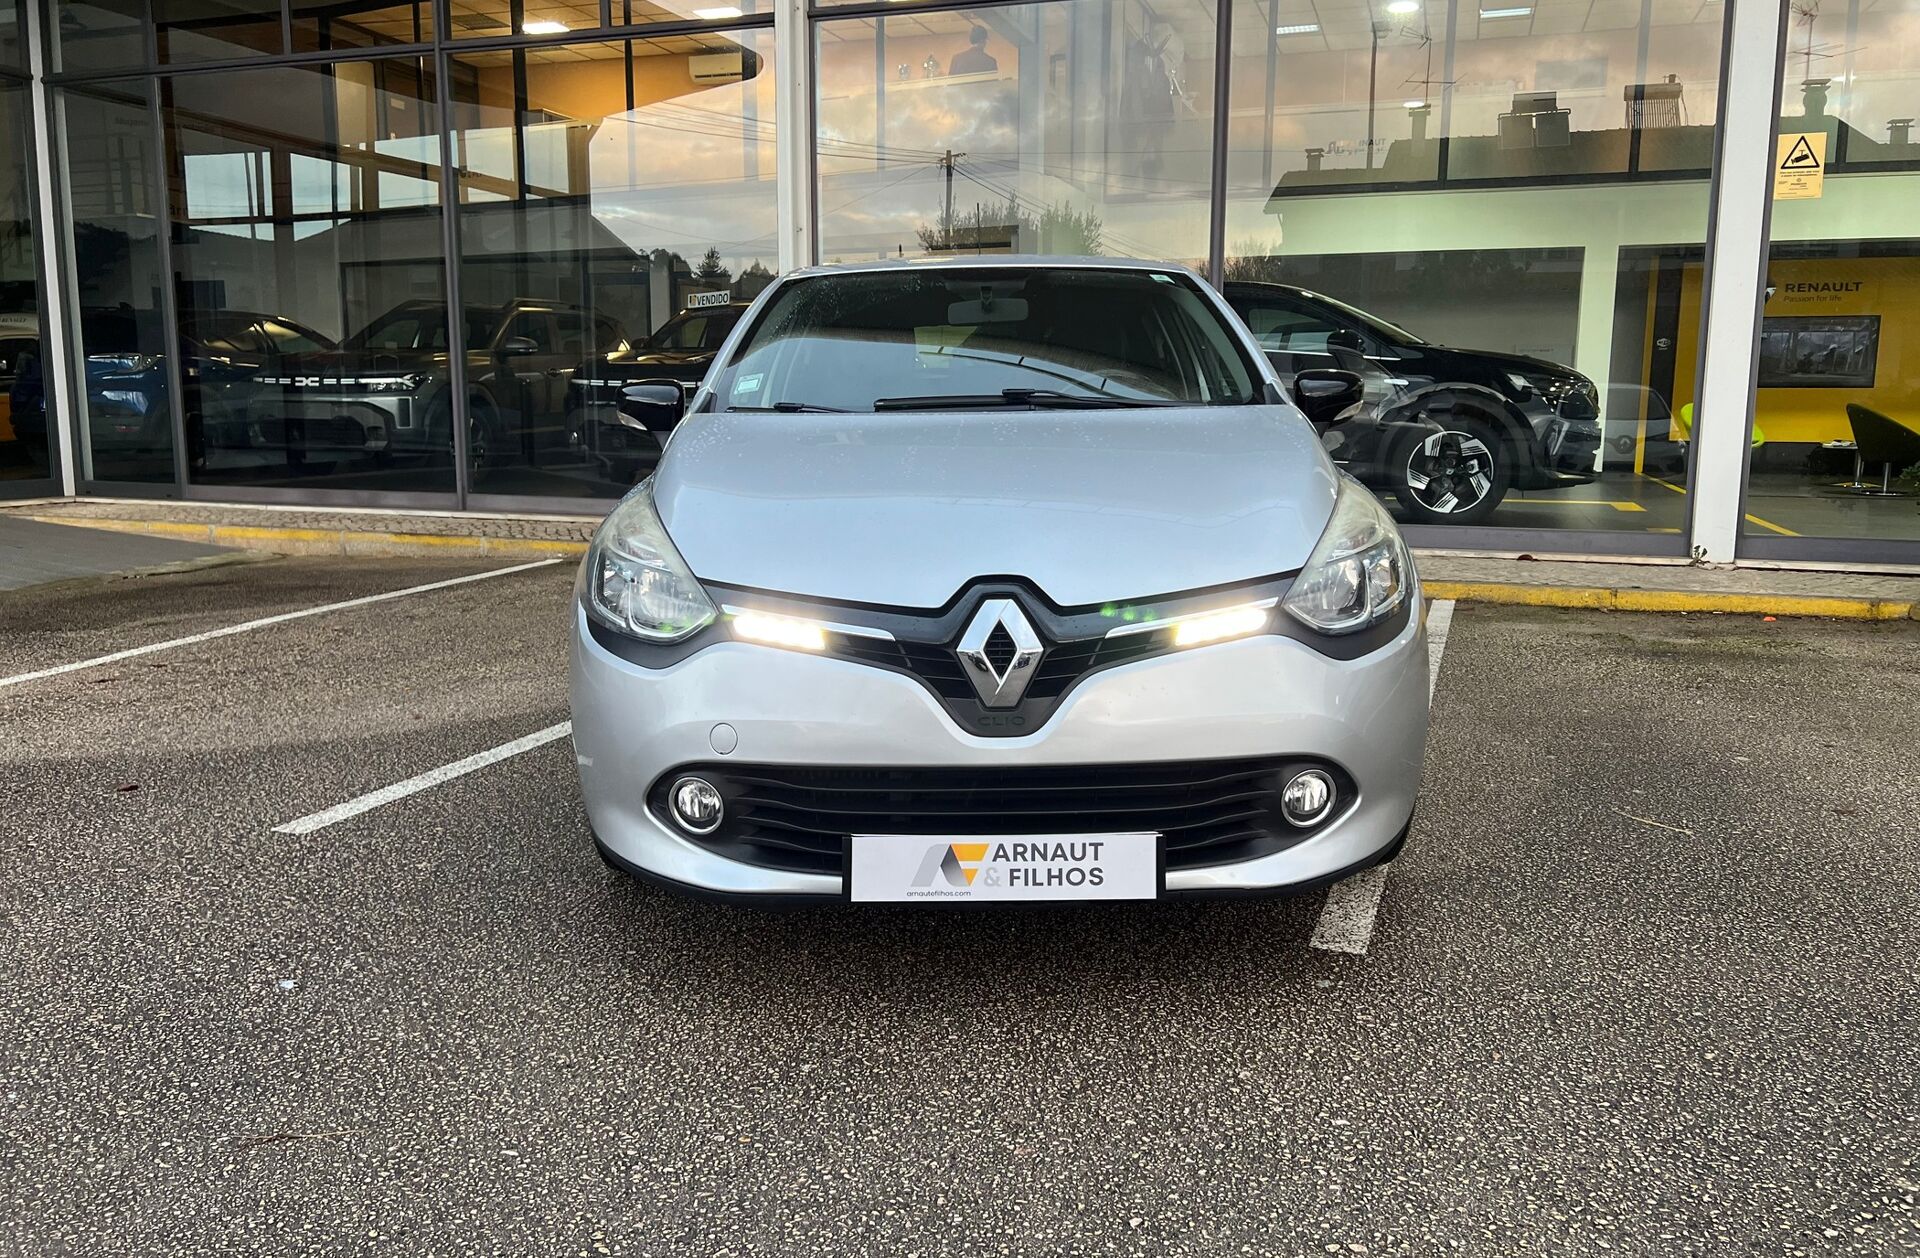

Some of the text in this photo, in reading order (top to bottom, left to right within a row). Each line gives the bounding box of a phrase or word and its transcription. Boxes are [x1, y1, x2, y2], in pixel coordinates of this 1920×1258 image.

[1785, 282, 1863, 292] RENAULT
[696, 293, 729, 306] VENDIDO
[1816, 294, 1827, 302] for
[1829, 294, 1842, 302] life
[977, 716, 1026, 726] CLIO
[991, 842, 1104, 863] ARNAUT
[983, 867, 1104, 887] & FILHOS
